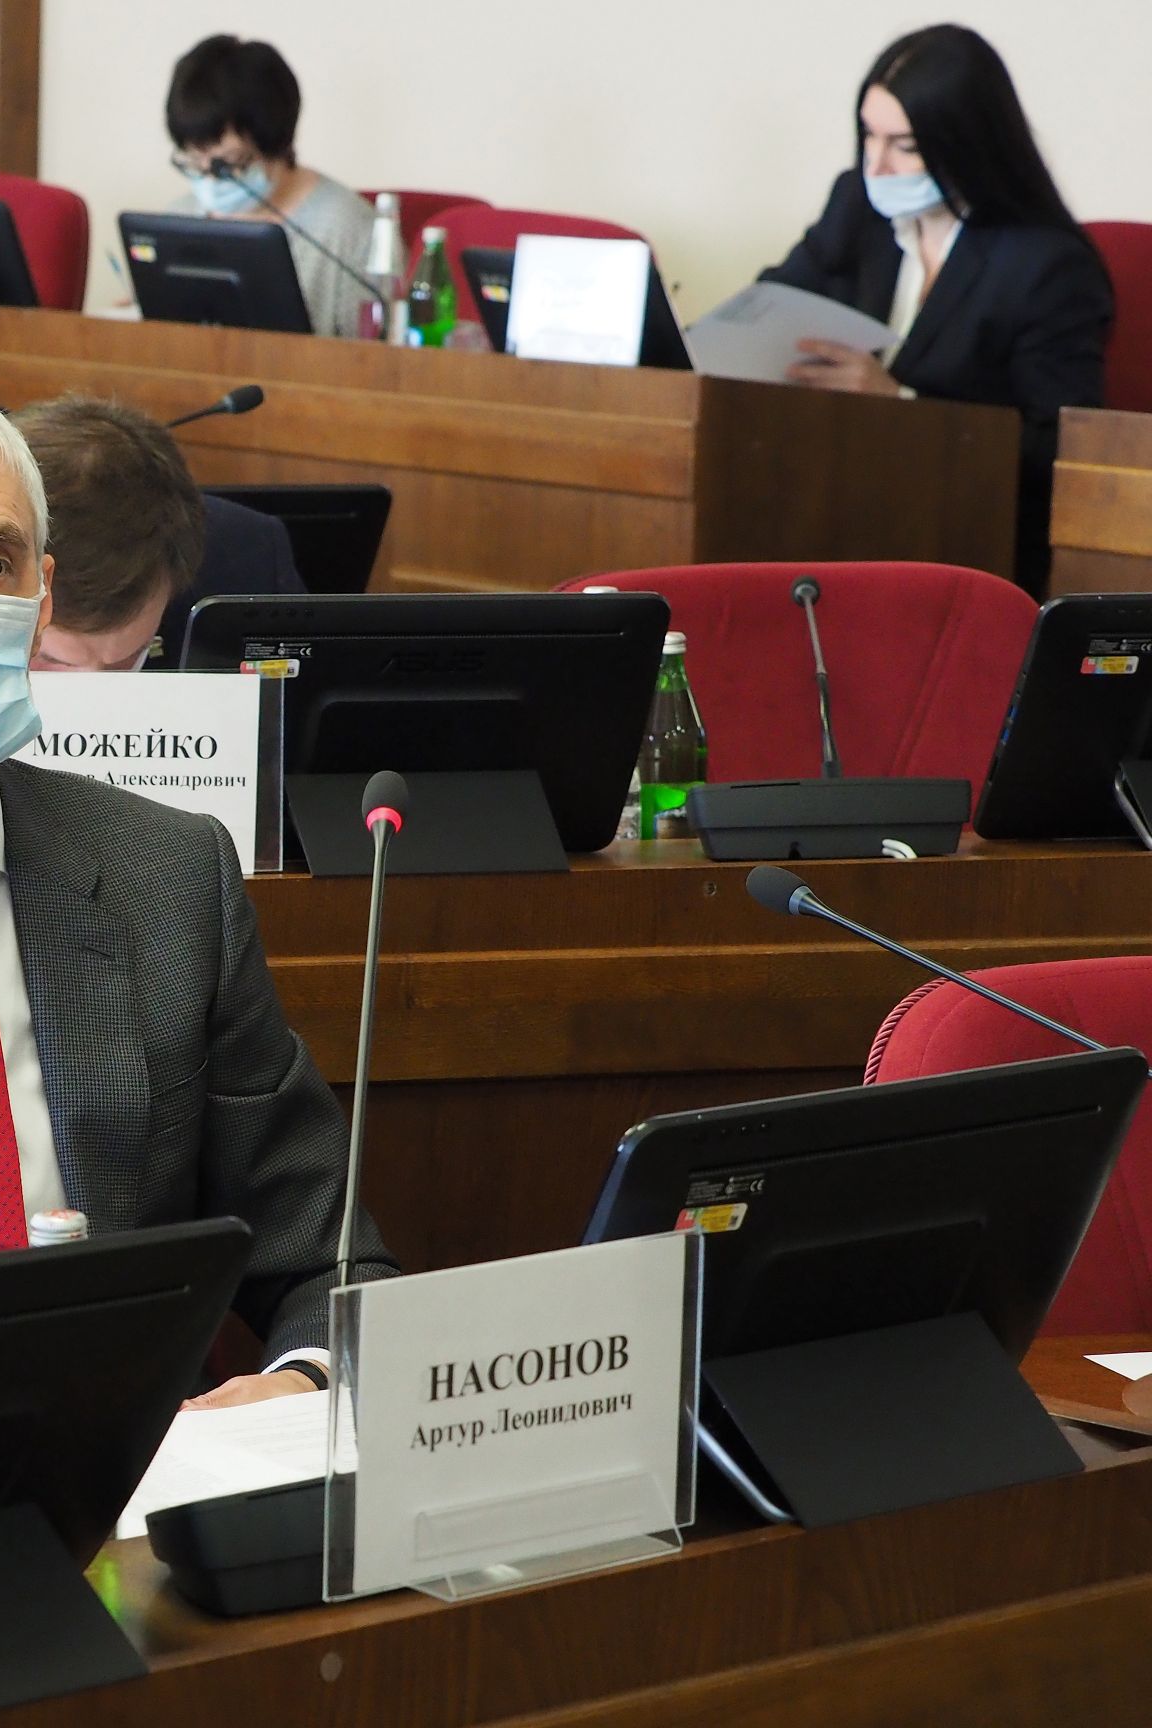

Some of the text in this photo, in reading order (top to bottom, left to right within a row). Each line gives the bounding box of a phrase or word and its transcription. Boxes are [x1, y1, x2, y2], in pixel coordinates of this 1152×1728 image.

[380, 650, 486, 674] ASUS
[32, 728, 219, 760] МОЖЕЙКО
[103, 771, 247, 791] Александрович
[428, 1334, 630, 1402] НАСОНОВ
[410, 1393, 633, 1453] Артур Леонидович
